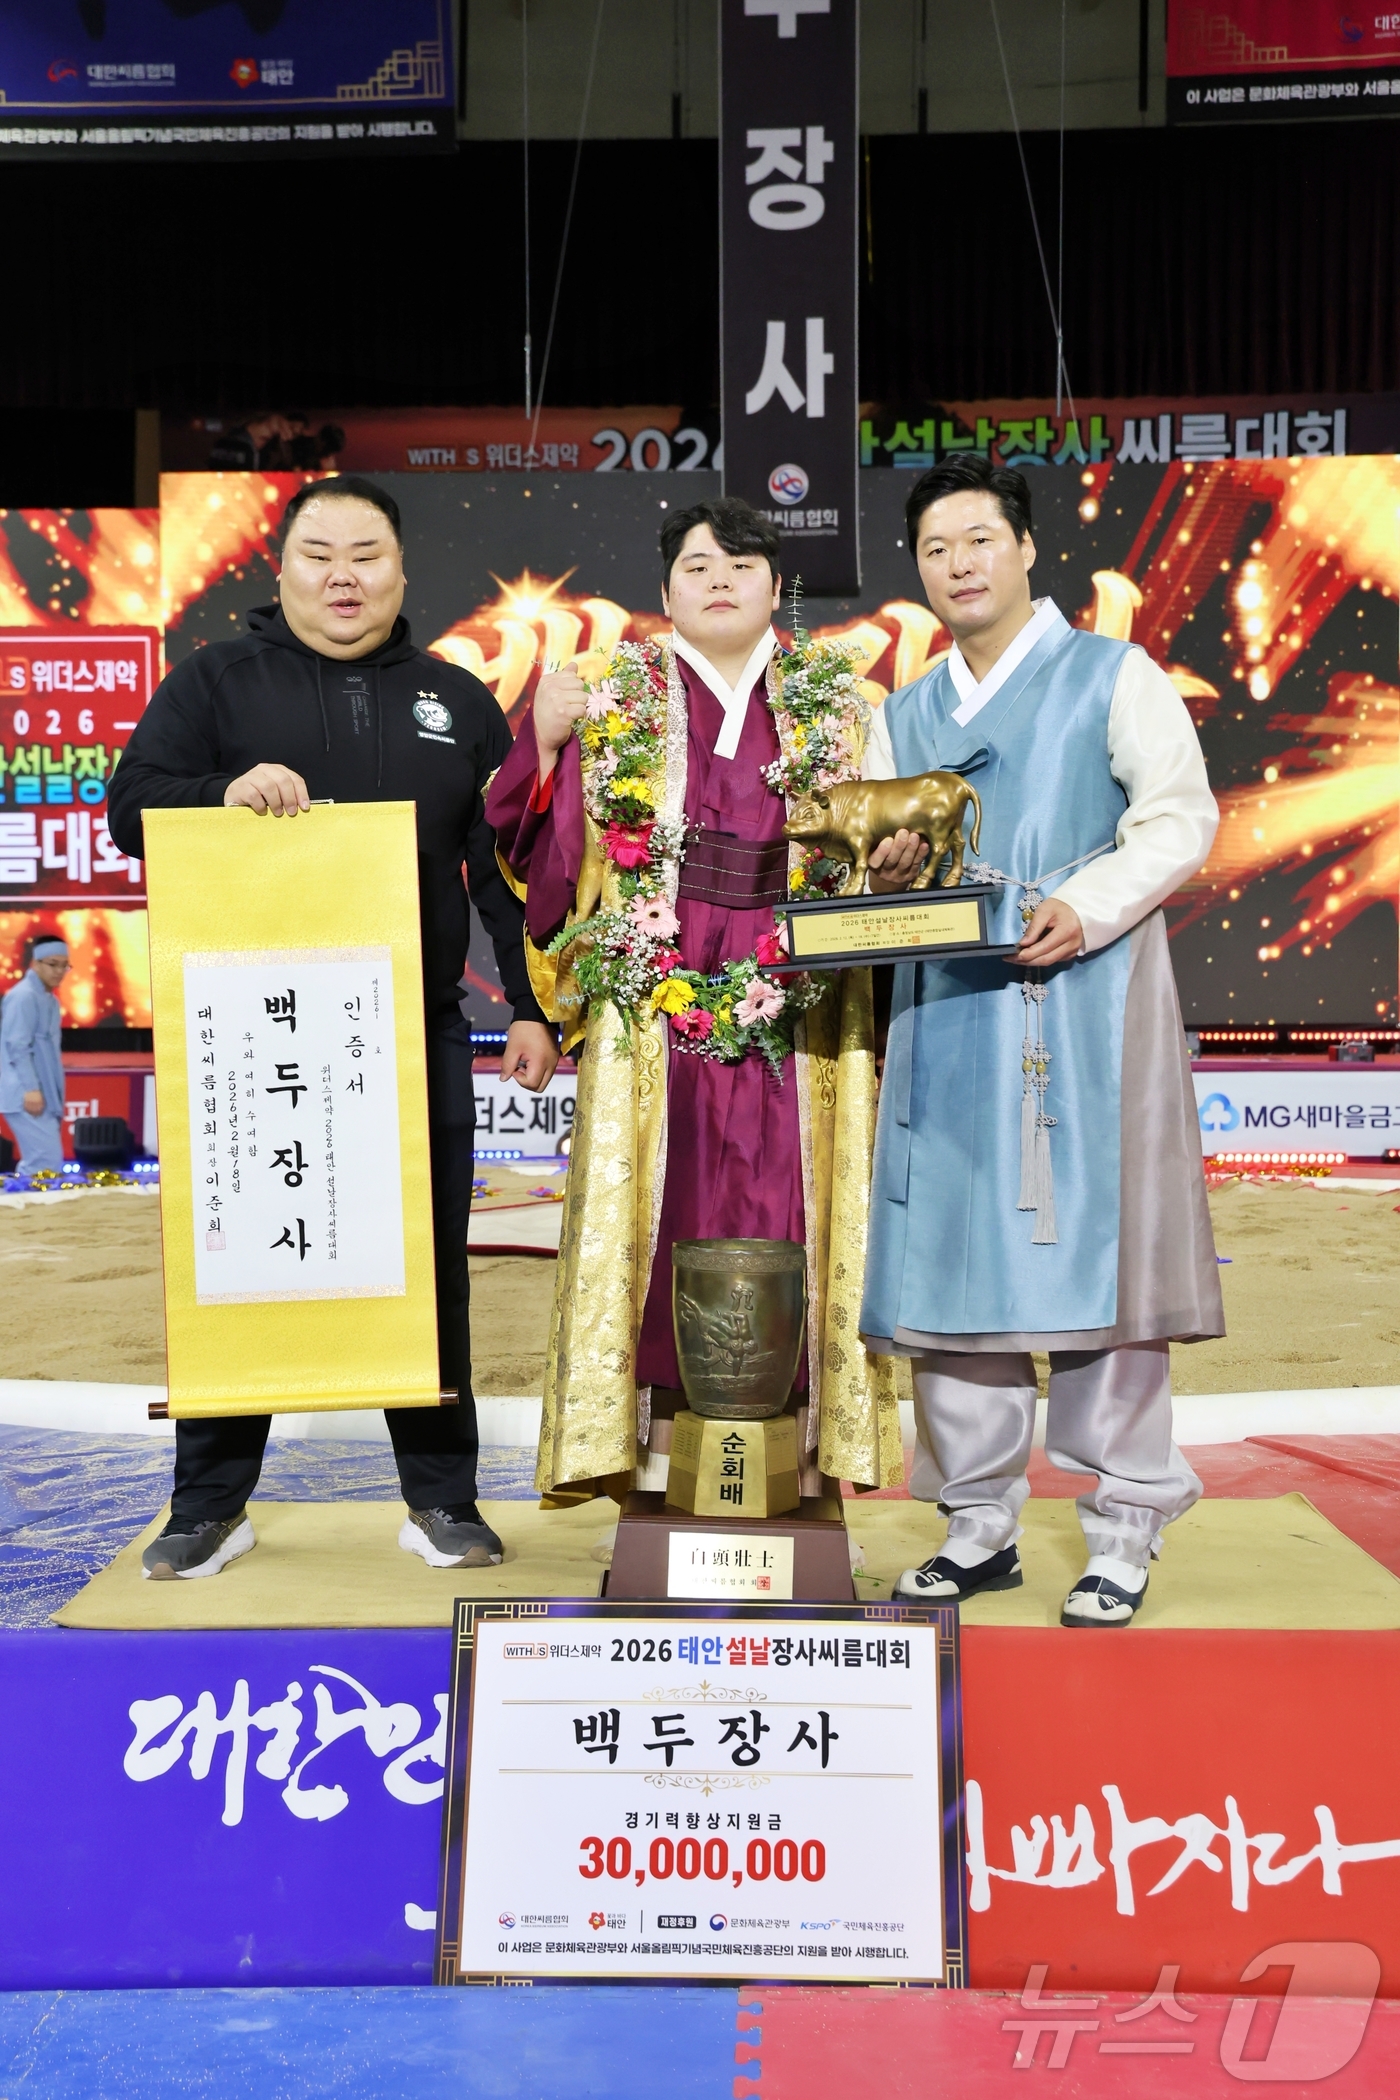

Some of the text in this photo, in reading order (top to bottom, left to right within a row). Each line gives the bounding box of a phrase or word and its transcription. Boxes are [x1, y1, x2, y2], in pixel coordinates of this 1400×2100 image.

[261, 69, 294, 86] 태안
[1186, 89, 1200, 104] 이
[486, 443, 579, 468] 위더스제약
[591, 427, 722, 472] 202
[760, 509, 838, 528] 씨름협회
[32, 660, 138, 692] 위더스제약
[0, 743, 123, 805] 설날장
[841, 919, 860, 928] 2026
[344, 995, 366, 1096] 인증서
[197, 1005, 217, 1136] 대한씨름협회
[263, 988, 312, 1262] 백두장사
[325, 1119, 333, 1148] 2026
[205, 1171, 224, 1233] 이준희
[719, 1431, 747, 1506] 순회배
[549, 1644, 602, 1658] 위더스제약
[610, 1638, 673, 1663] 2026
[678, 1636, 911, 1669] 태안설날장사씨름대회
[572, 1708, 840, 1769] 백두장사
[624, 1811, 783, 1832] 경기력향상지원금
[578, 1836, 827, 1889] 30,000,000
[520, 1914, 569, 1924] 대한씨름협회
[607, 1919, 627, 1930] 태안
[660, 1917, 694, 1928] 재정후원
[730, 1918, 790, 1929] 문화체육관광부
[800, 1921, 831, 1931] KSPO
[842, 1921, 905, 1932] 국민체육진흥공단
[498, 1942, 909, 1960] 이 사업은 문화체육관광부와 서울올림픽기념국민체육진흥공단의 지원을 받아 시행합니다.
